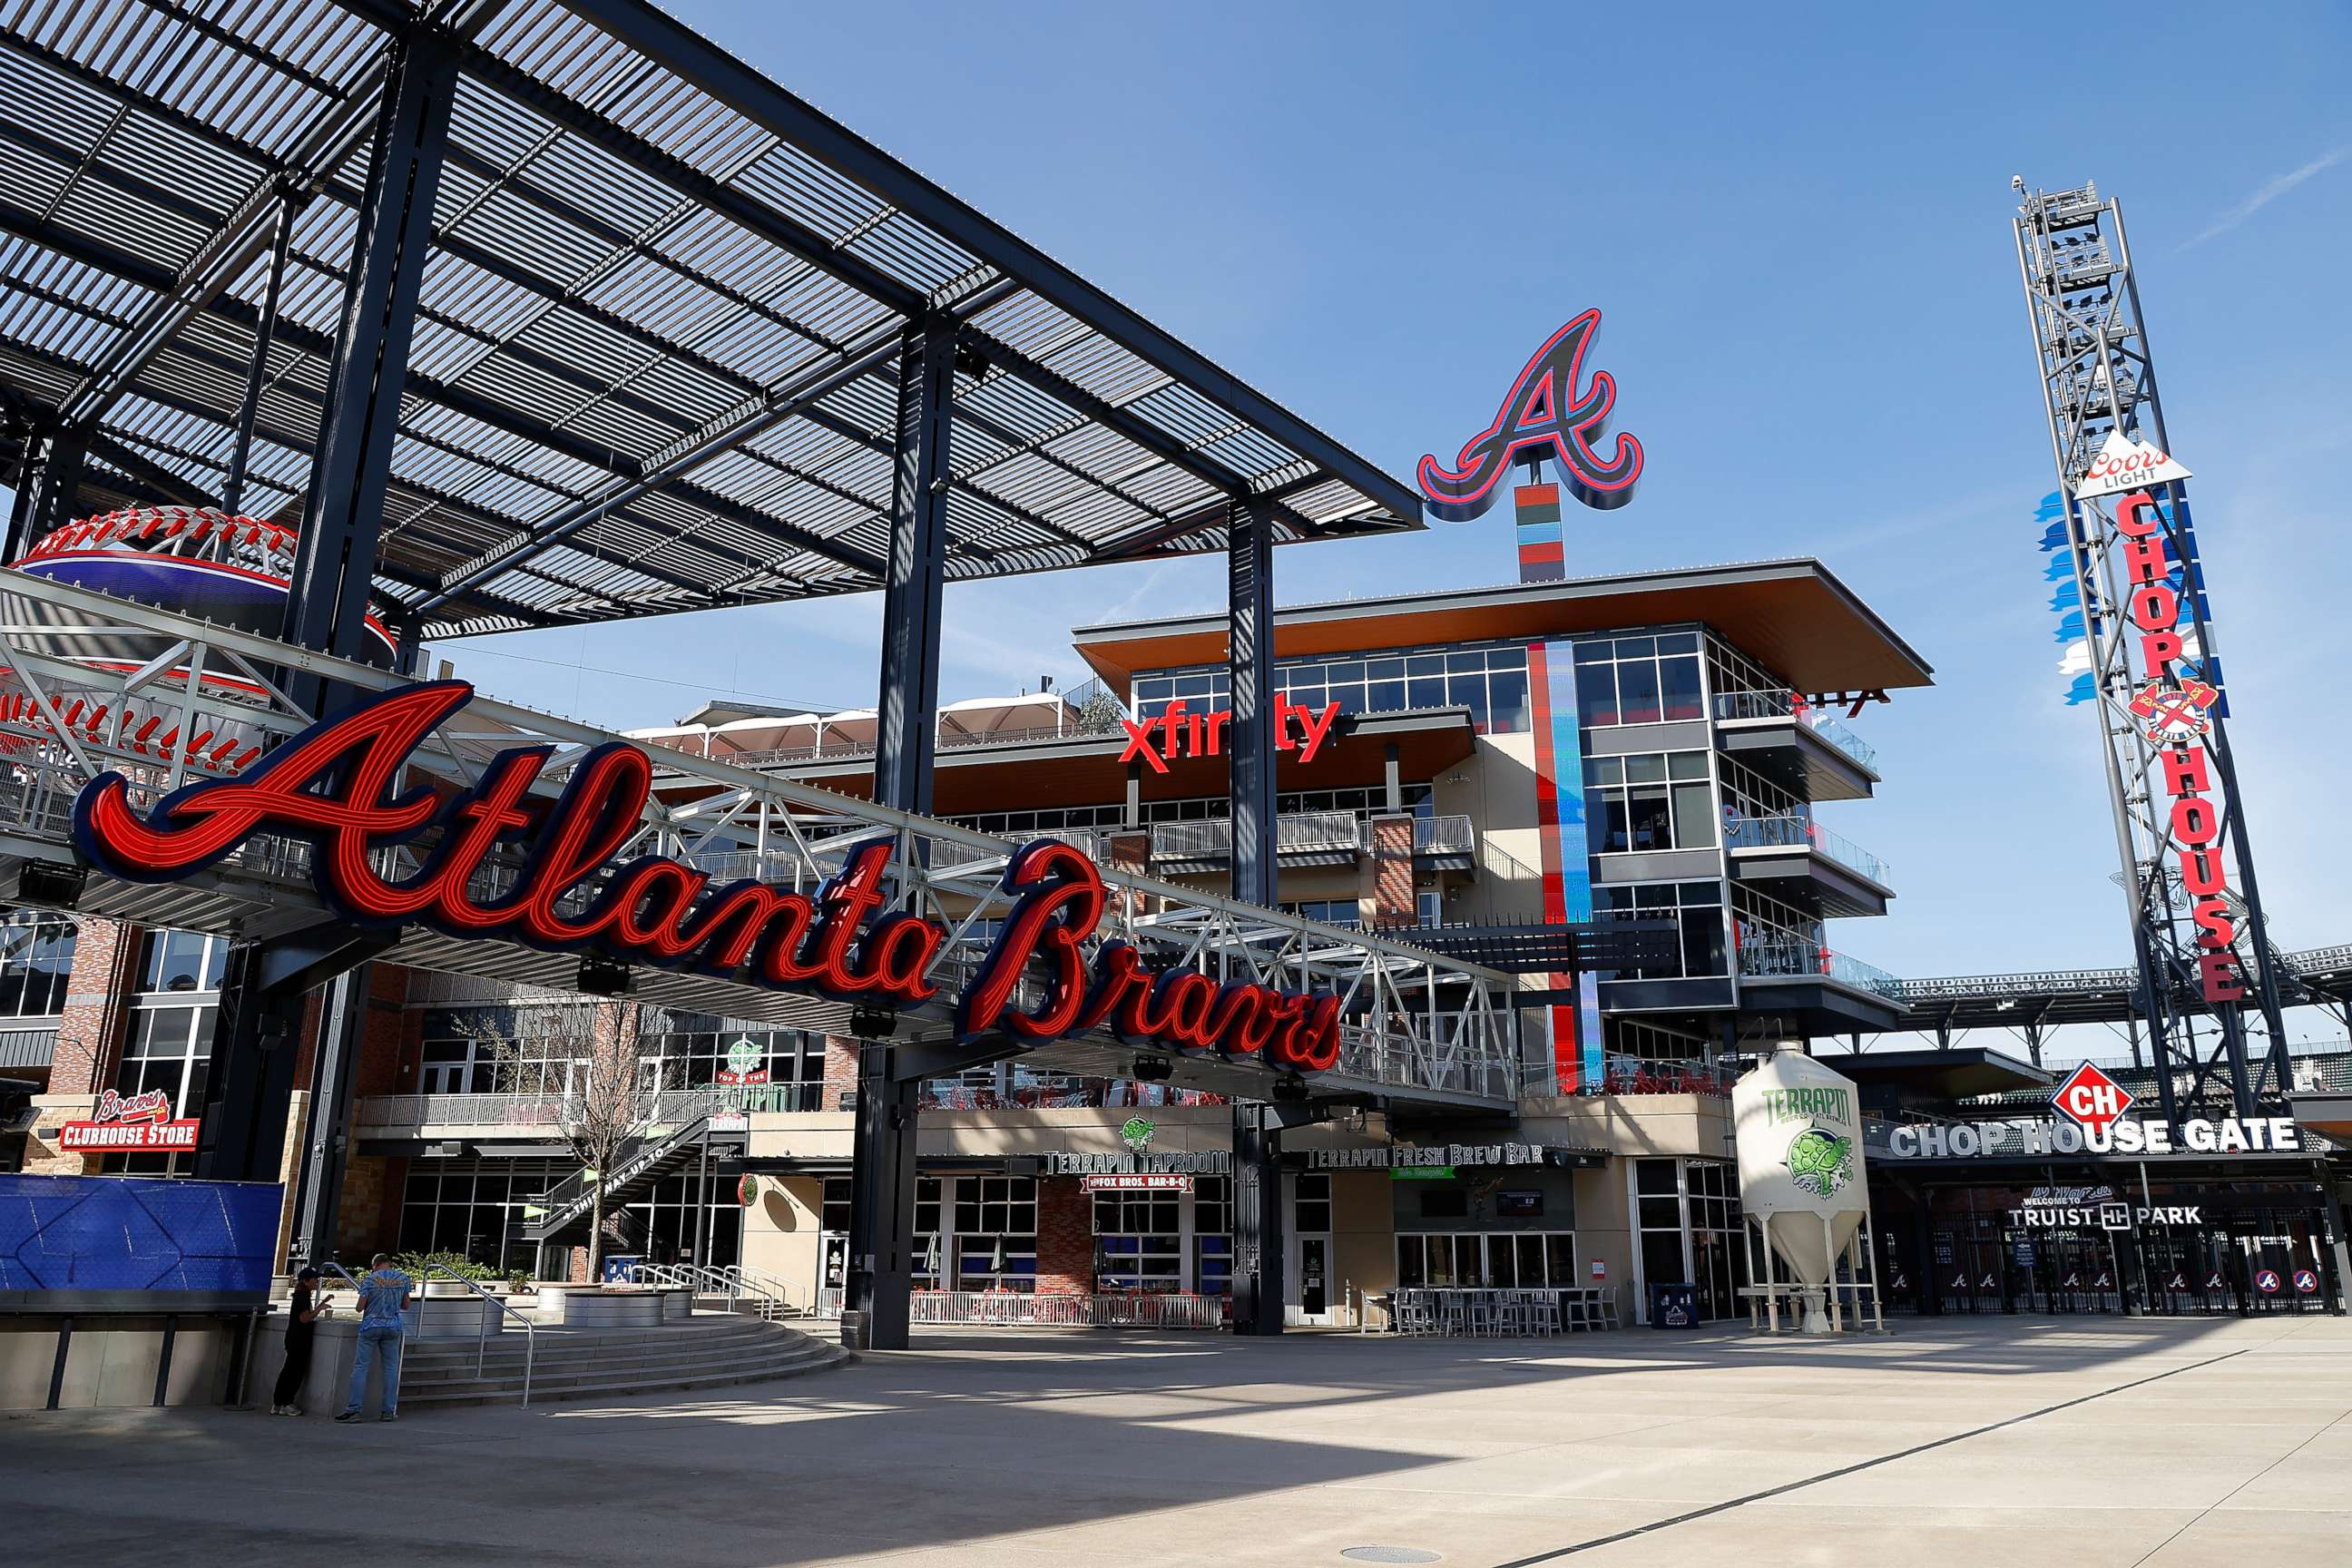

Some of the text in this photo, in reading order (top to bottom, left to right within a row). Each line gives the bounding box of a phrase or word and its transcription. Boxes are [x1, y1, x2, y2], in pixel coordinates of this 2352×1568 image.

[1416, 308, 1644, 519] A
[2087, 450, 2170, 479] Coors
[2104, 467, 2156, 488] LIGHT
[2116, 492, 2182, 678] CHOP
[1118, 692, 1341, 773] xfinty
[76, 679, 1343, 1075] Atlanta Braves
[2161, 745, 2243, 1003] HOUSE
[718, 1073, 732, 1082] TOP
[749, 1073, 765, 1082] THE
[94, 1089, 162, 1124] Braves
[1761, 1088, 1852, 1127] TERRAPIN
[2069, 1084, 2118, 1115] CH
[64, 1123, 195, 1146] CLUBHOUSE STORE
[1889, 1117, 2299, 1157] CHOP HOUSE GATE
[630, 1160, 646, 1176] UP
[648, 1148, 664, 1162] TO
[1043, 1150, 1230, 1174] TERRAPIN TAPROOM
[1307, 1142, 1544, 1169] TERRAPIN FRESH BREW BAR
[1099, 1177, 1117, 1187] FOX
[1120, 1177, 1145, 1187] BROS.
[1148, 1177, 1185, 1188] BAR-B-Q
[2008, 1206, 2203, 1226] TRUIST PARK
[2023, 1197, 2082, 1206] WELCOME TO
